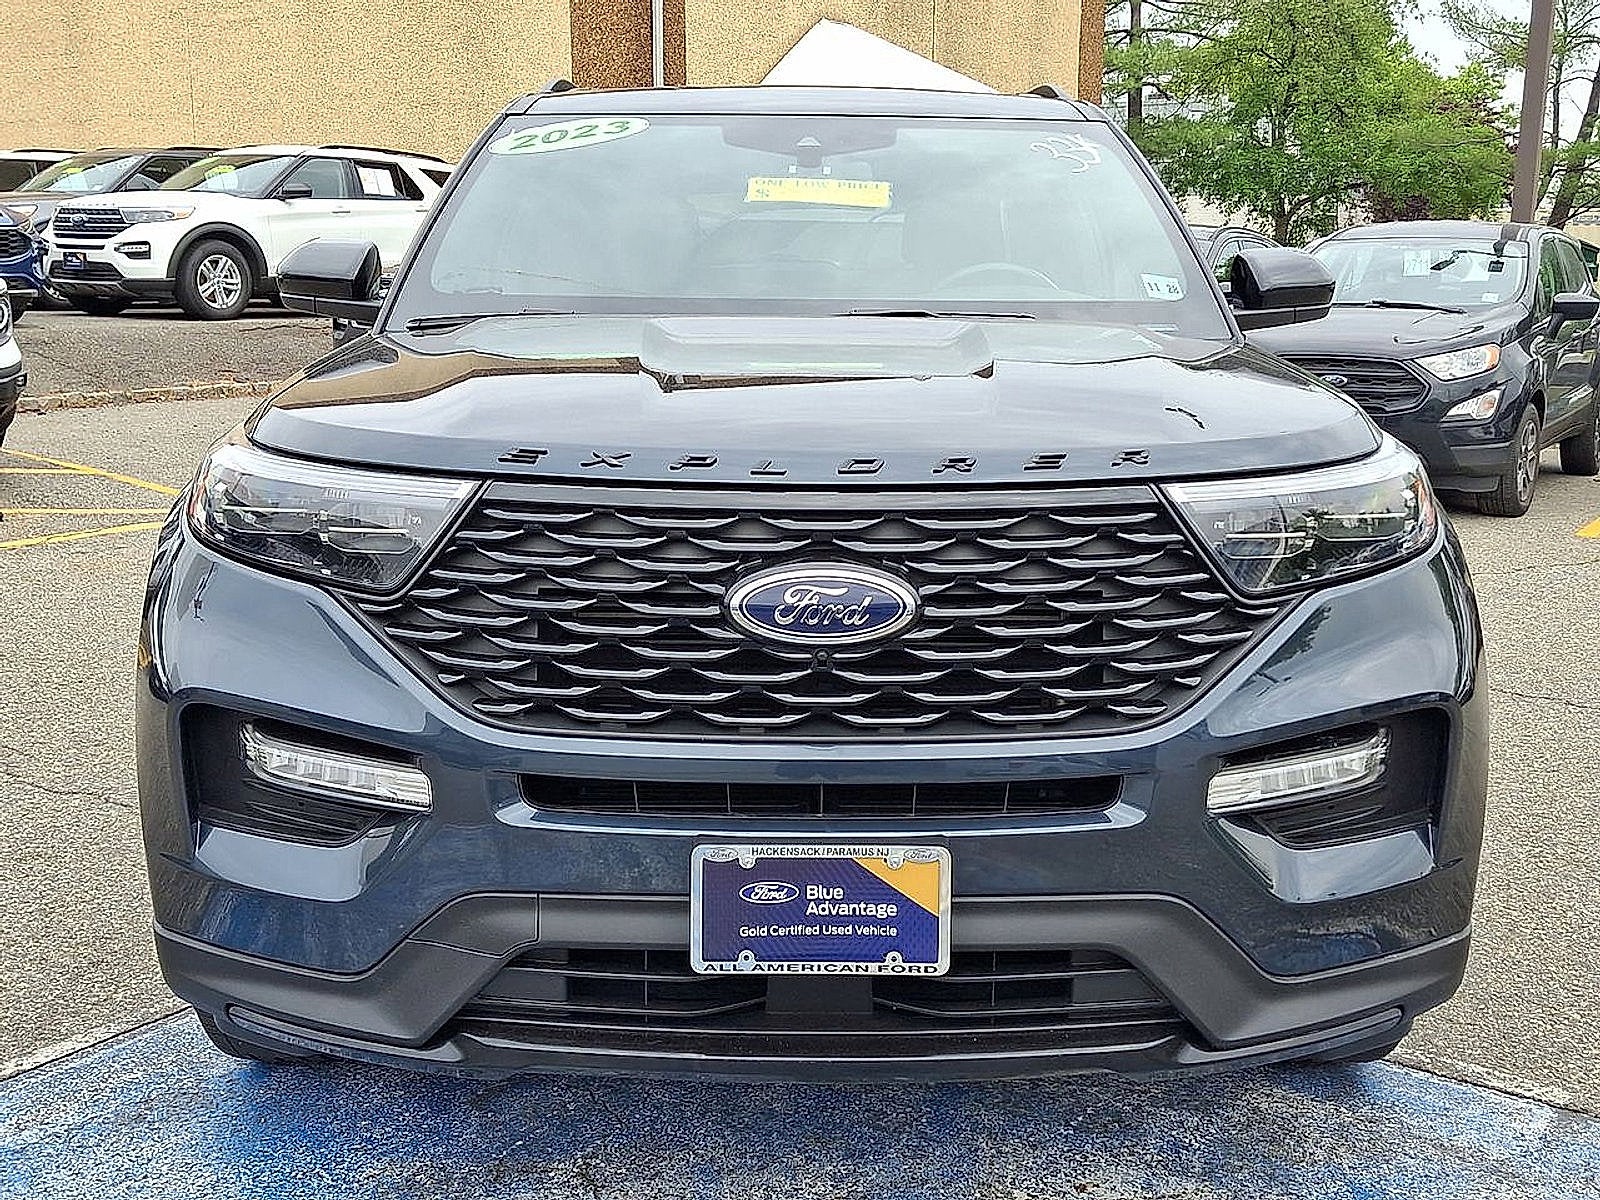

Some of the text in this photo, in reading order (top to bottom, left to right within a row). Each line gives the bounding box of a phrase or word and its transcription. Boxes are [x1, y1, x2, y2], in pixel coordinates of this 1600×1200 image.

[508, 120, 631, 151] 2023
[497, 448, 1151, 477] EXPLORER
[774, 583, 873, 626] Ford
[751, 847, 890, 857] HACKENSACK/PARAMUS NJ
[750, 883, 788, 900] Ford
[806, 884, 844, 900] Blue
[805, 901, 898, 918] Advantage
[740, 924, 898, 937] Gold Certified Used Vehicle
[703, 963, 938, 973] ALL AMERICAN FORD
